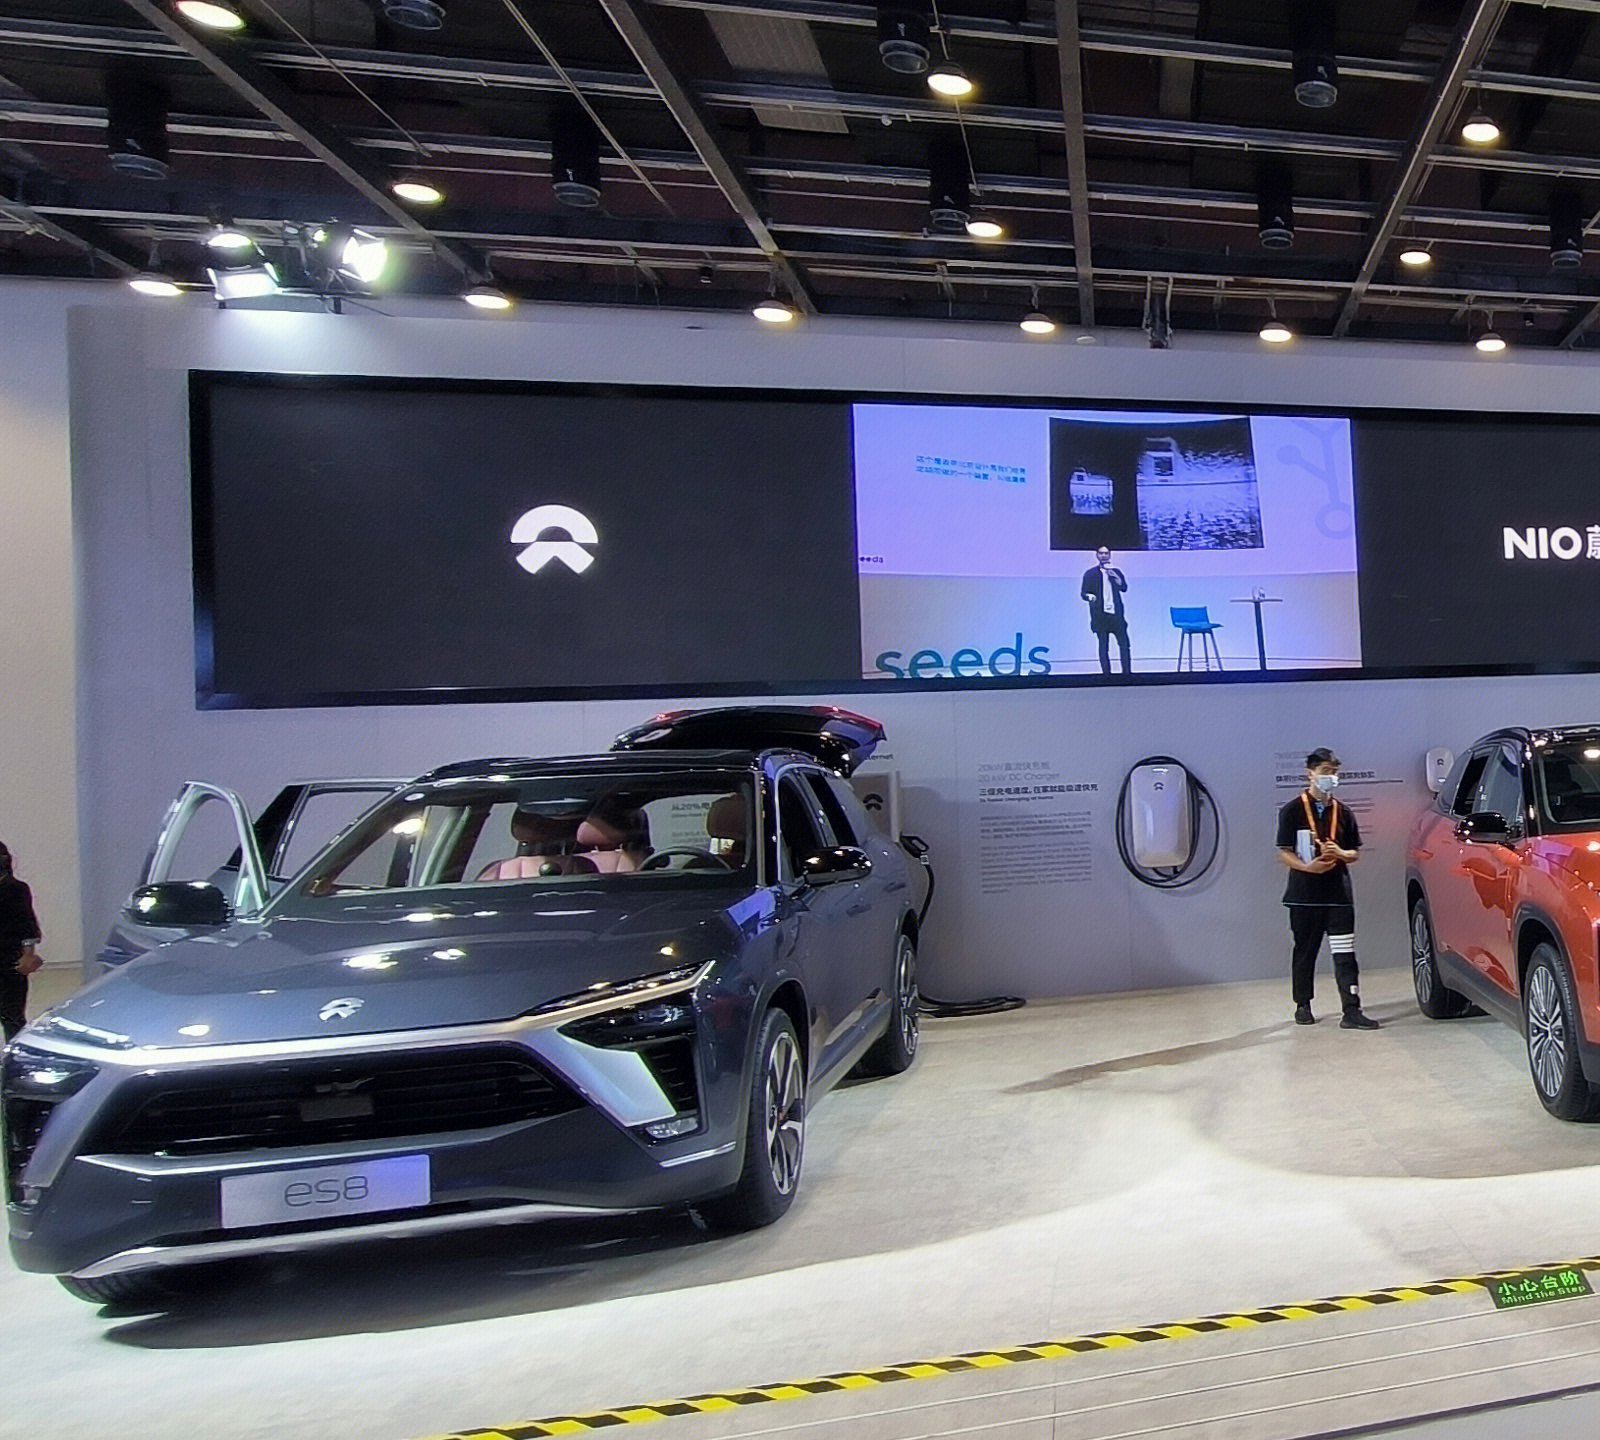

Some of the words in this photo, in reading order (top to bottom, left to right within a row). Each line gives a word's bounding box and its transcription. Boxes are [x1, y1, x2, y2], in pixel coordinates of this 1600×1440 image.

[1502, 525, 1583, 560] NIO
[875, 632, 1052, 679] seeds
[284, 1175, 369, 1208] es8
[1498, 1270, 1580, 1296] 小心台阶
[1501, 1292, 1533, 1305] Mind
[1535, 1288, 1556, 1299] the
[1557, 1284, 1586, 1295] Step
